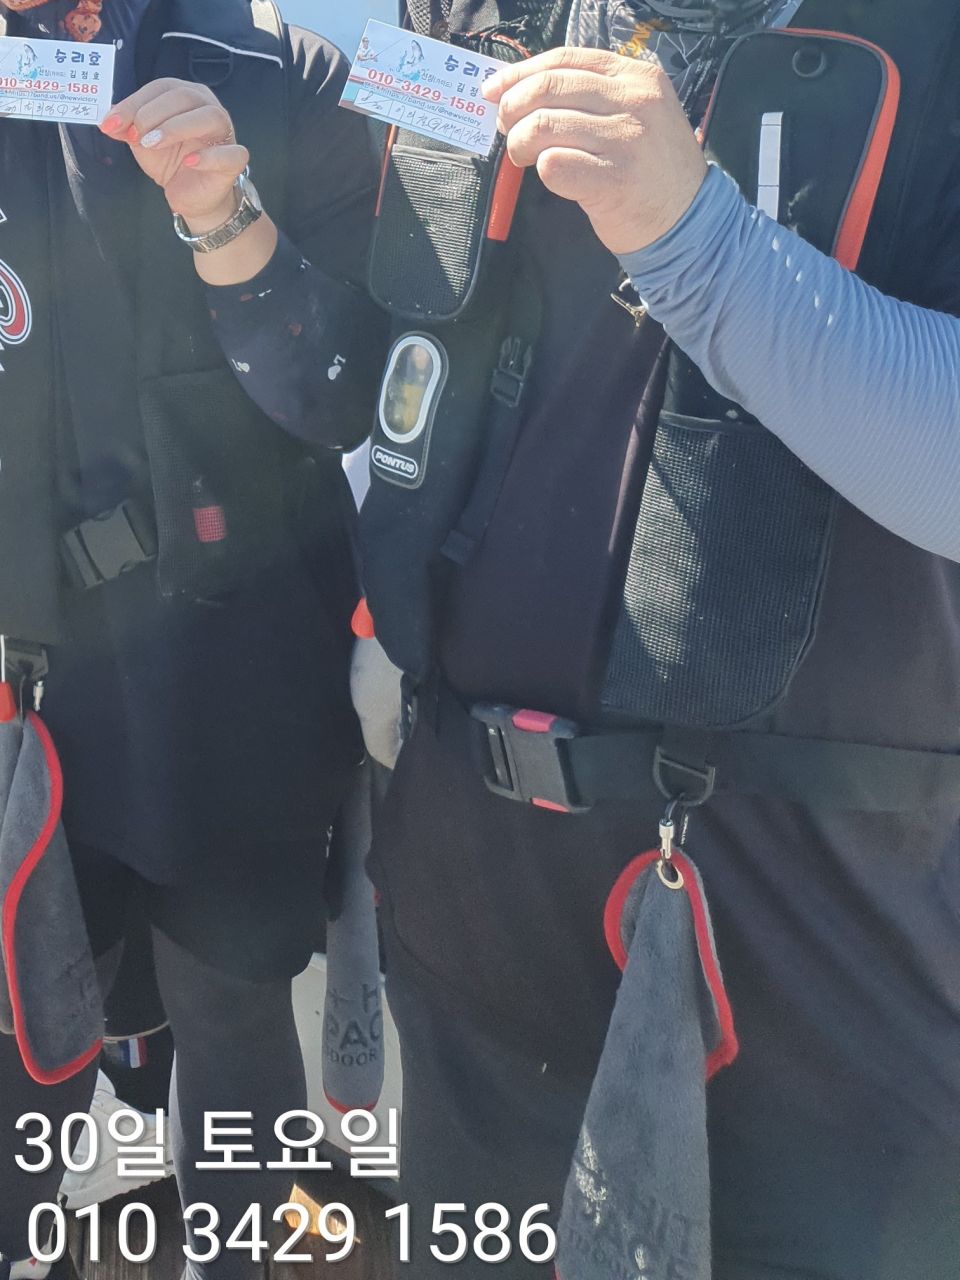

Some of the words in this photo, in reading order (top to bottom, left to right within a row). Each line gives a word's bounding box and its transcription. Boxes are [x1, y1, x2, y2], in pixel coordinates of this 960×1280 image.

[54, 48, 102, 66] 승리호
[368, 68, 486, 117] 010-3429-1586
[375, 451, 415, 473] PONTUS
